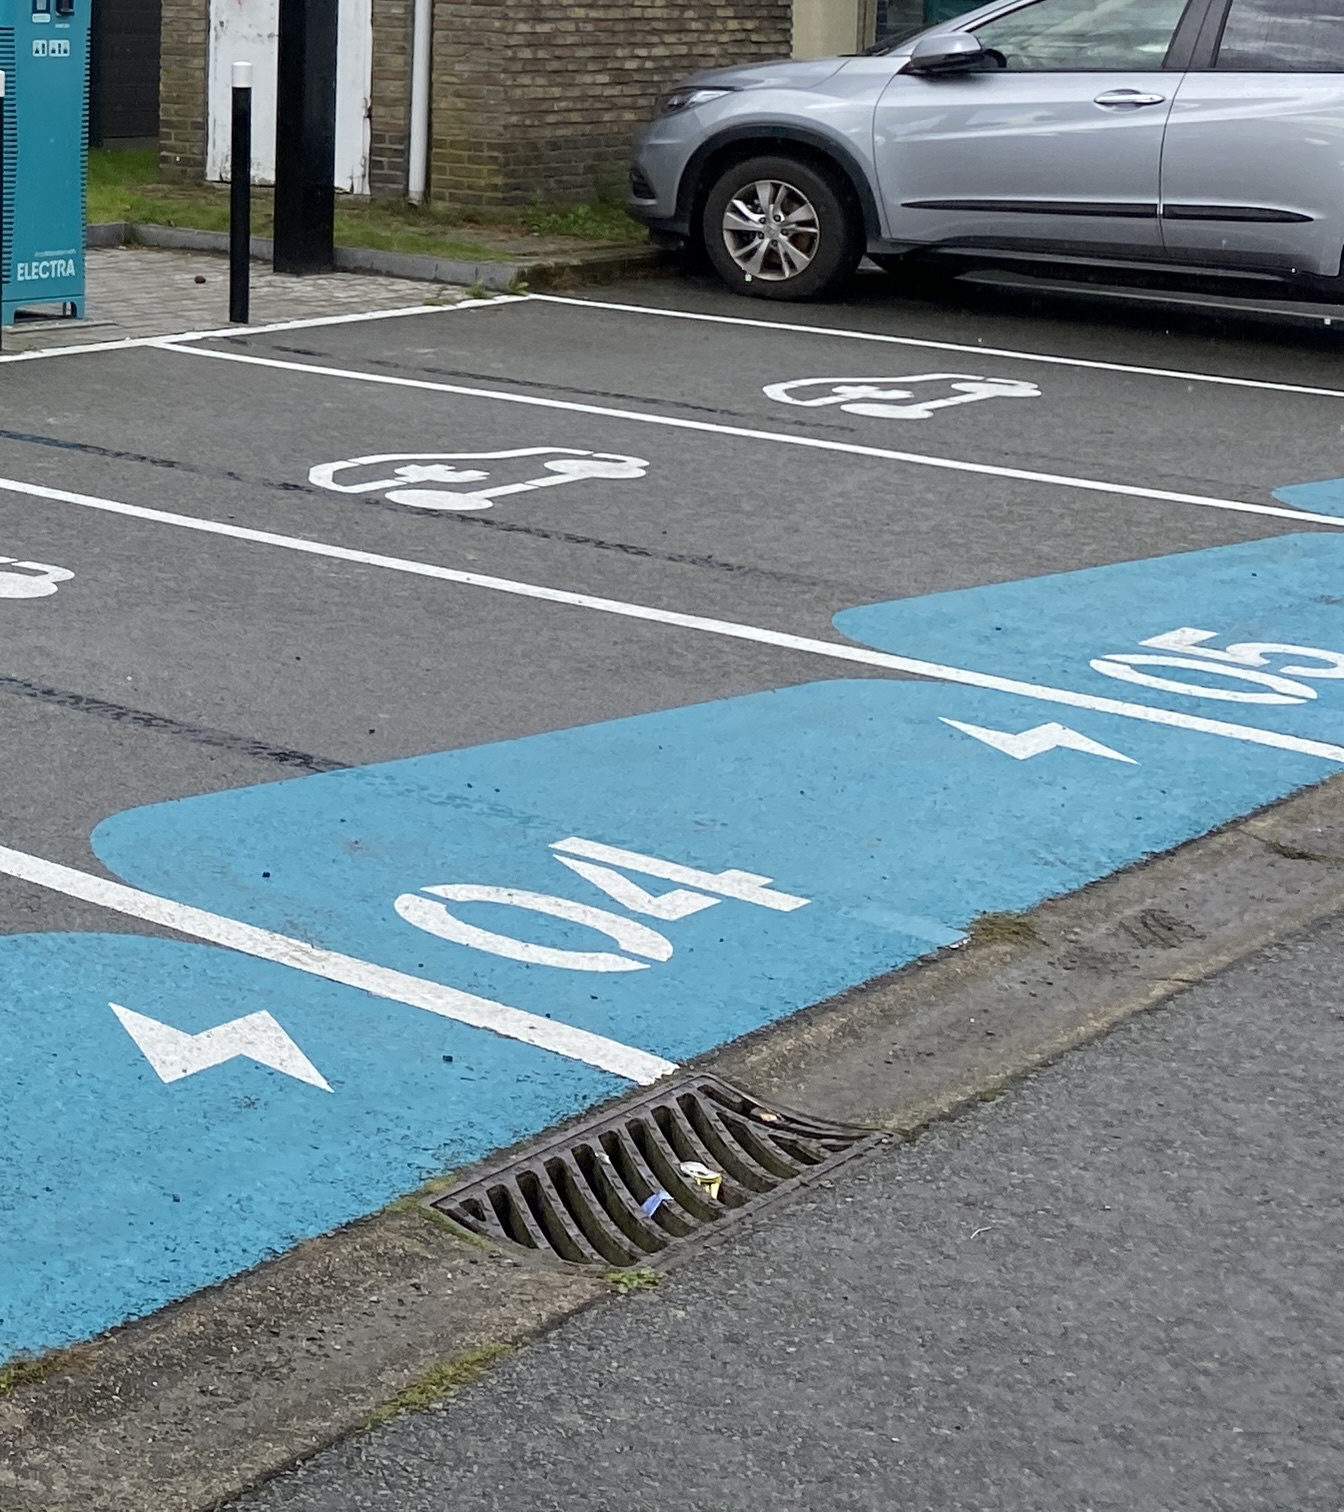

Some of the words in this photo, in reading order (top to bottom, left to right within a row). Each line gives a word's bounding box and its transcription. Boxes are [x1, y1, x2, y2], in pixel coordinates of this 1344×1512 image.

[17, 258, 76, 281] ELECTRA
[1089, 627, 1344, 705] 05
[394, 836, 812, 973] 04
